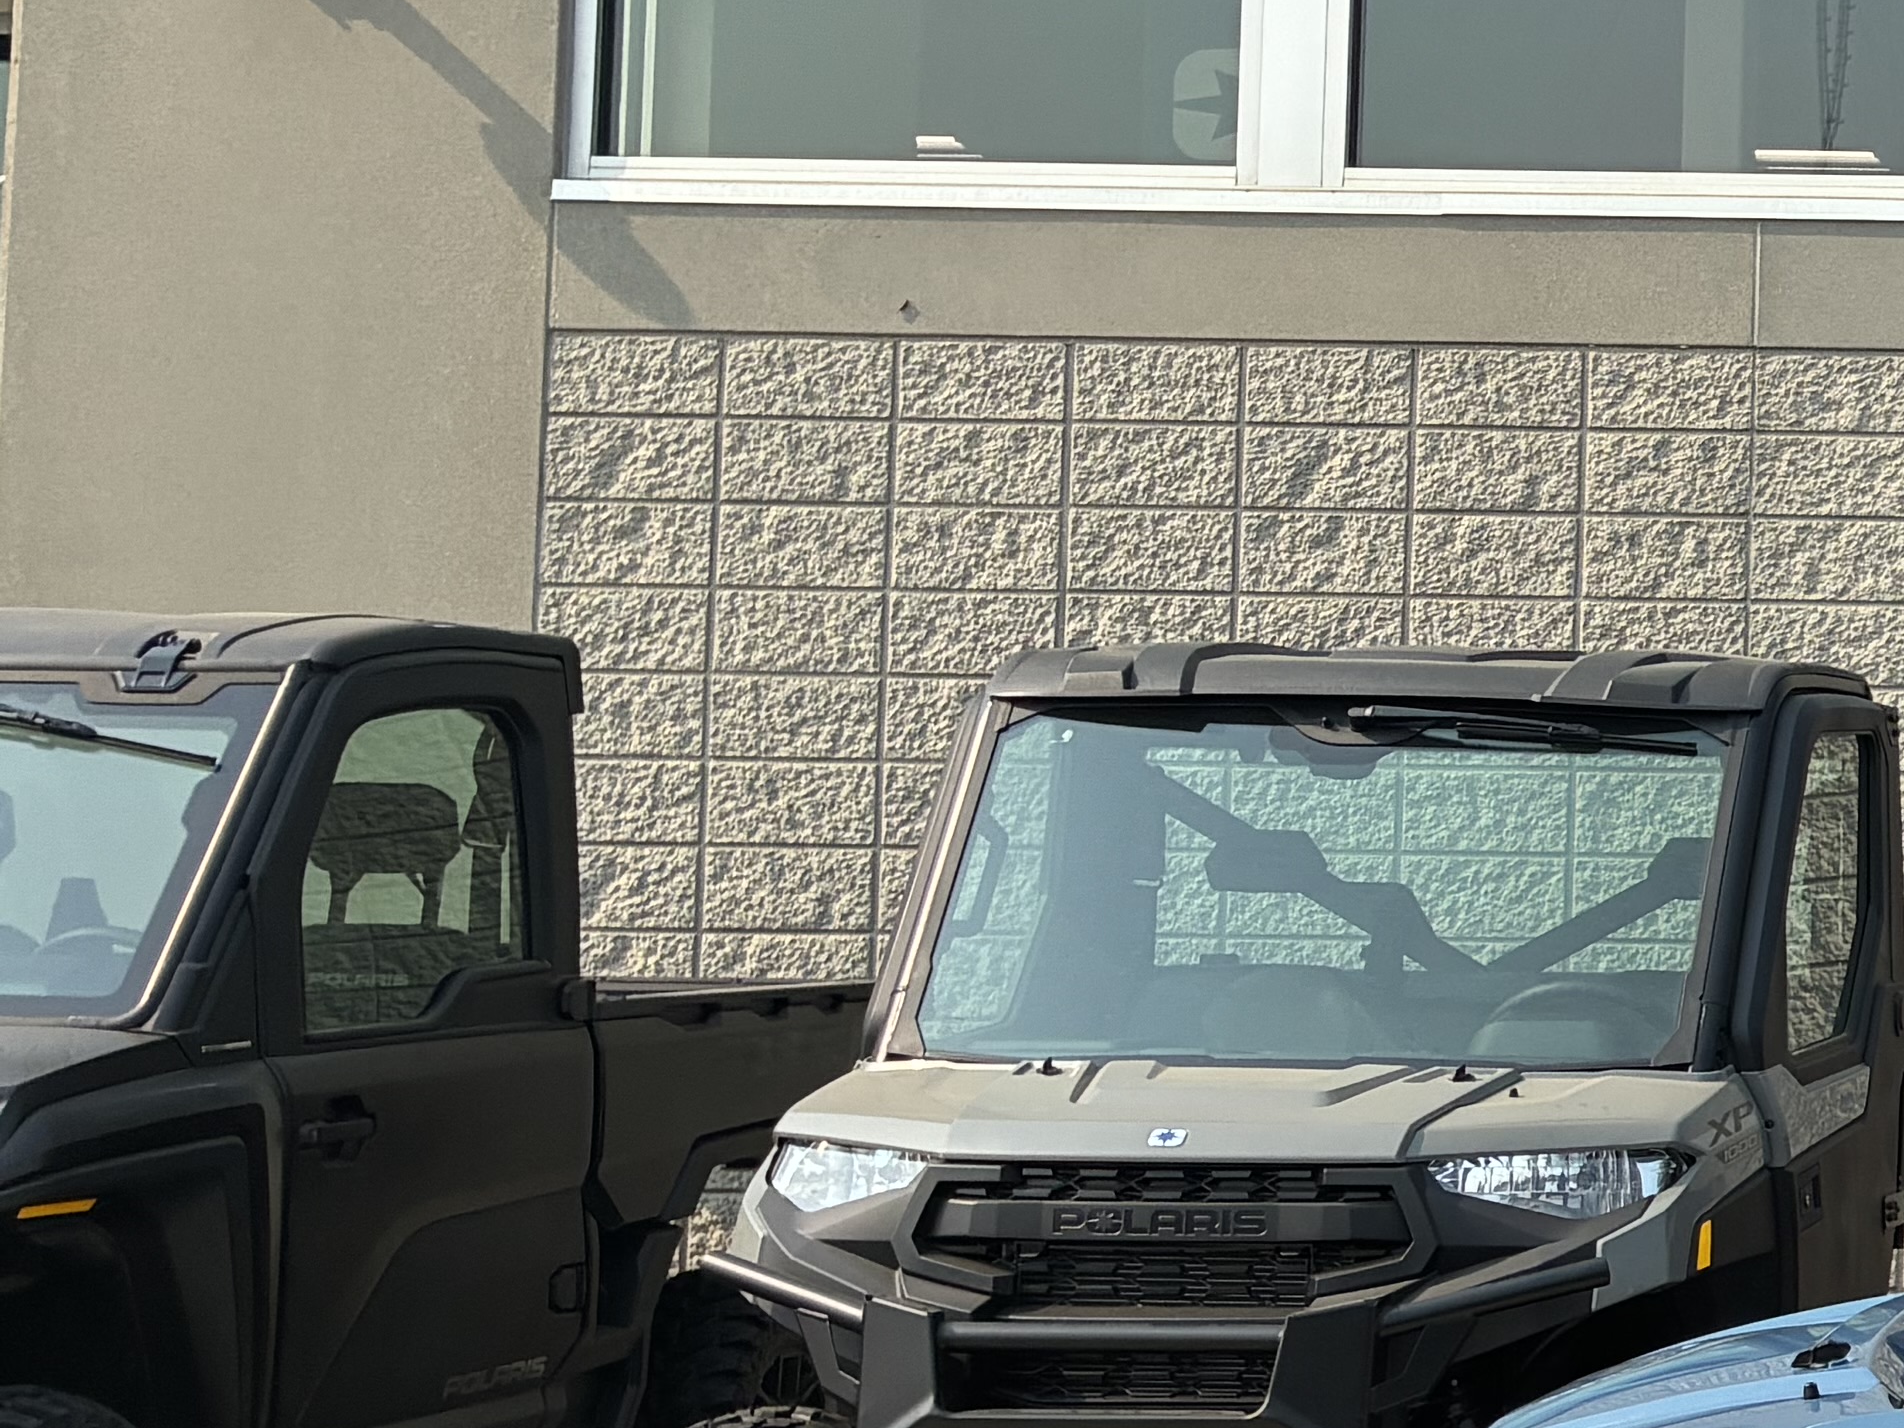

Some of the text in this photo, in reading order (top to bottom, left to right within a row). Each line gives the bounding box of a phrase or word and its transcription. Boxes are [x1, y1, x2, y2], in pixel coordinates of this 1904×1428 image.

[1707, 1100, 1754, 1148] XP
[1723, 1134, 1759, 1164] 1000
[1052, 1208, 1268, 1237] POLARIS
[442, 1356, 548, 1399] POLARIS
